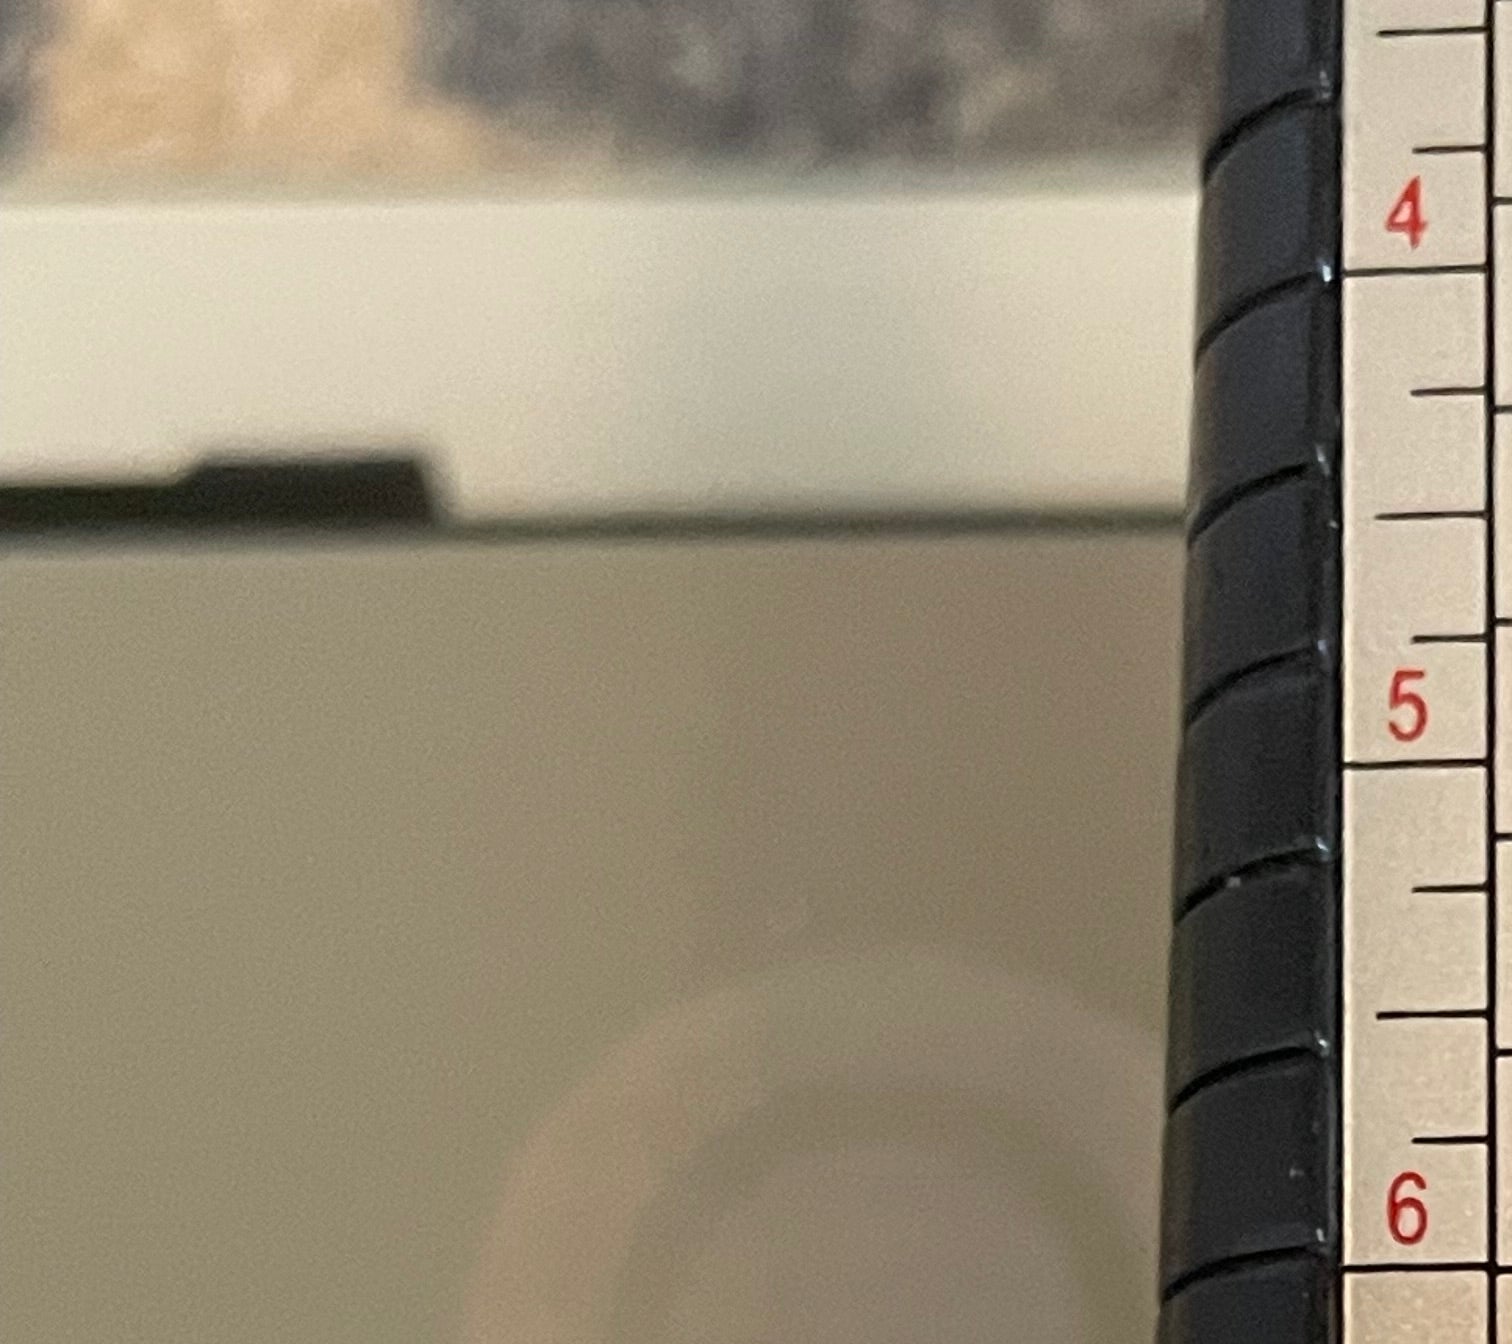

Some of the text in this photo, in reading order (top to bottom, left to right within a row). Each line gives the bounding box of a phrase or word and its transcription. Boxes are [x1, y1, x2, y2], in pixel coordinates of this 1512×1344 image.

[1386, 175, 1427, 248] 4
[1388, 669, 1428, 741] 5
[1387, 1171, 1429, 1245] 6
